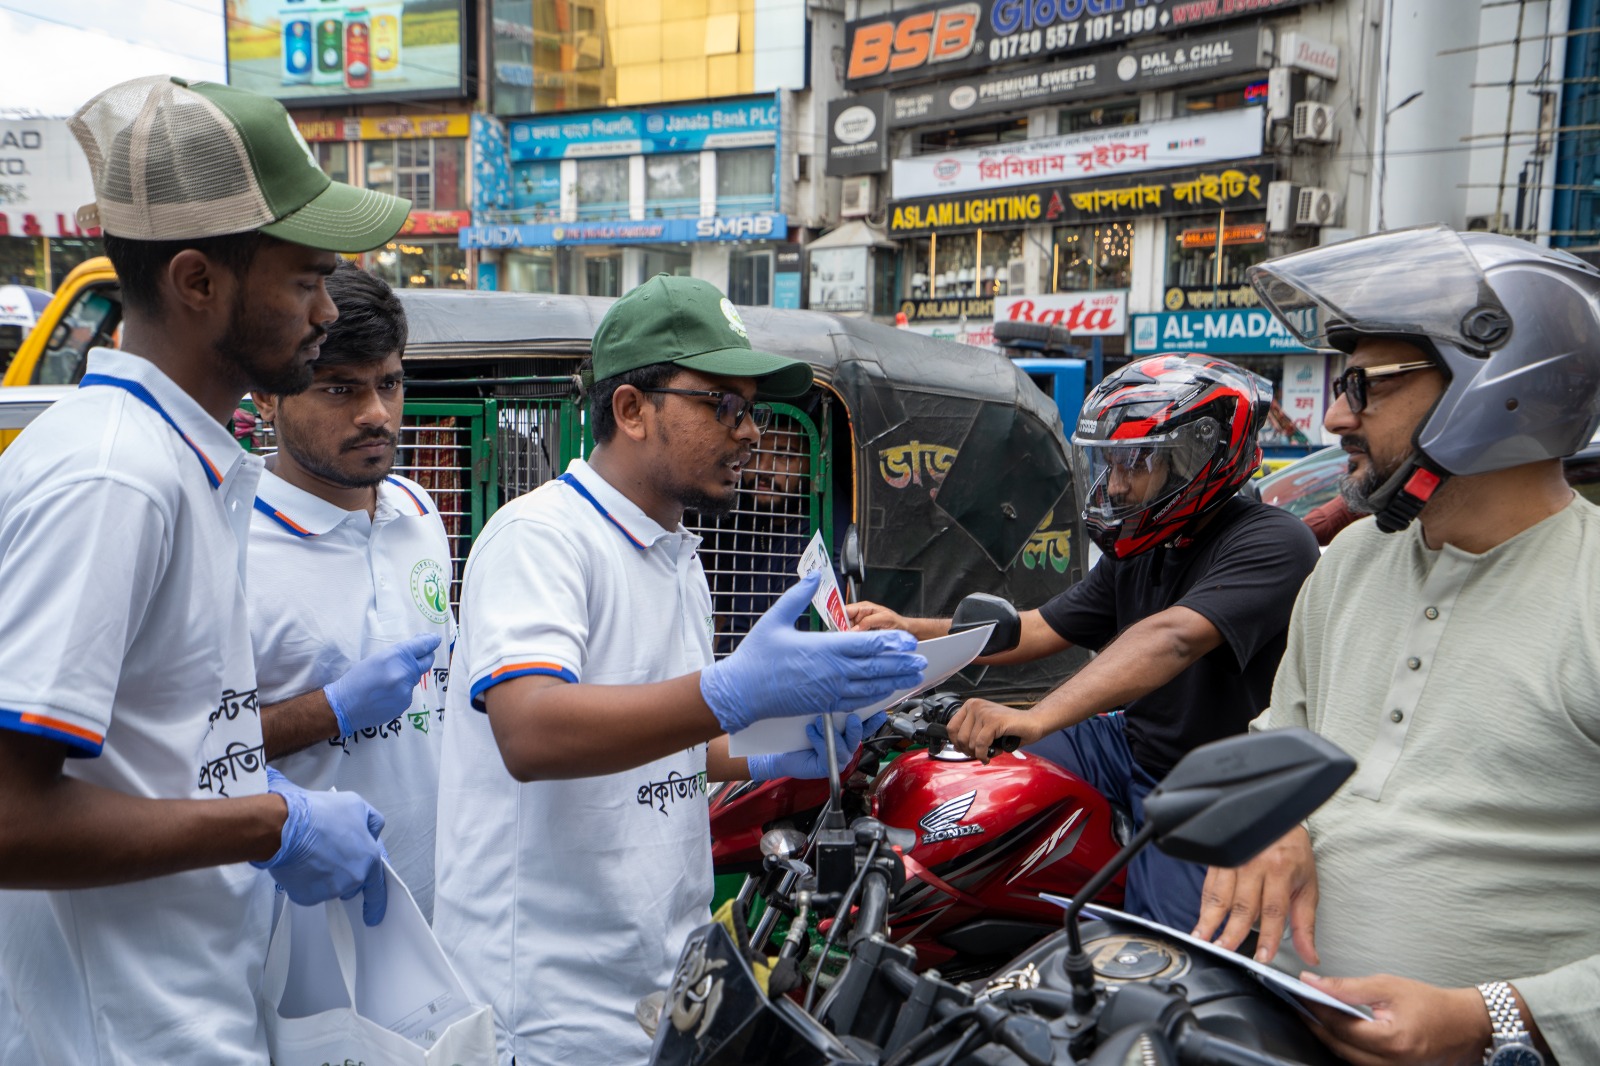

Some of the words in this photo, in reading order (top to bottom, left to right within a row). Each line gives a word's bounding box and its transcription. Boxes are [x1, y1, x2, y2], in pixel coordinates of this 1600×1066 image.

[847, 3, 981, 79] BSB
[989, 30, 1042, 60] 01720
[1045, 22, 1080, 50] 557
[1084, 5, 1157, 42] 101-199
[1141, 51, 1171, 70] DAL
[1174, 48, 1186, 64] &
[1190, 40, 1233, 61] CHAL
[1296, 37, 1337, 70] Bata
[979, 75, 1039, 97] PREMIUM
[1040, 64, 1096, 86] SWEETS
[666, 114, 710, 131] Janata
[712, 109, 748, 128] Bank
[749, 106, 779, 125] PLC
[978, 151, 1066, 181] প্রিমিয়াম
[1076, 142, 1149, 172] সুইটস
[1070, 184, 1164, 213] আসলাম
[1171, 169, 1262, 205] লাইটিং
[467, 226, 524, 246] HUIDA
[696, 215, 773, 237] SMAB
[916, 300, 959, 318] ASLAM
[961, 297, 994, 316] LIGHT
[1007, 298, 1117, 331] Bata
[921, 823, 986, 846] HONDA
